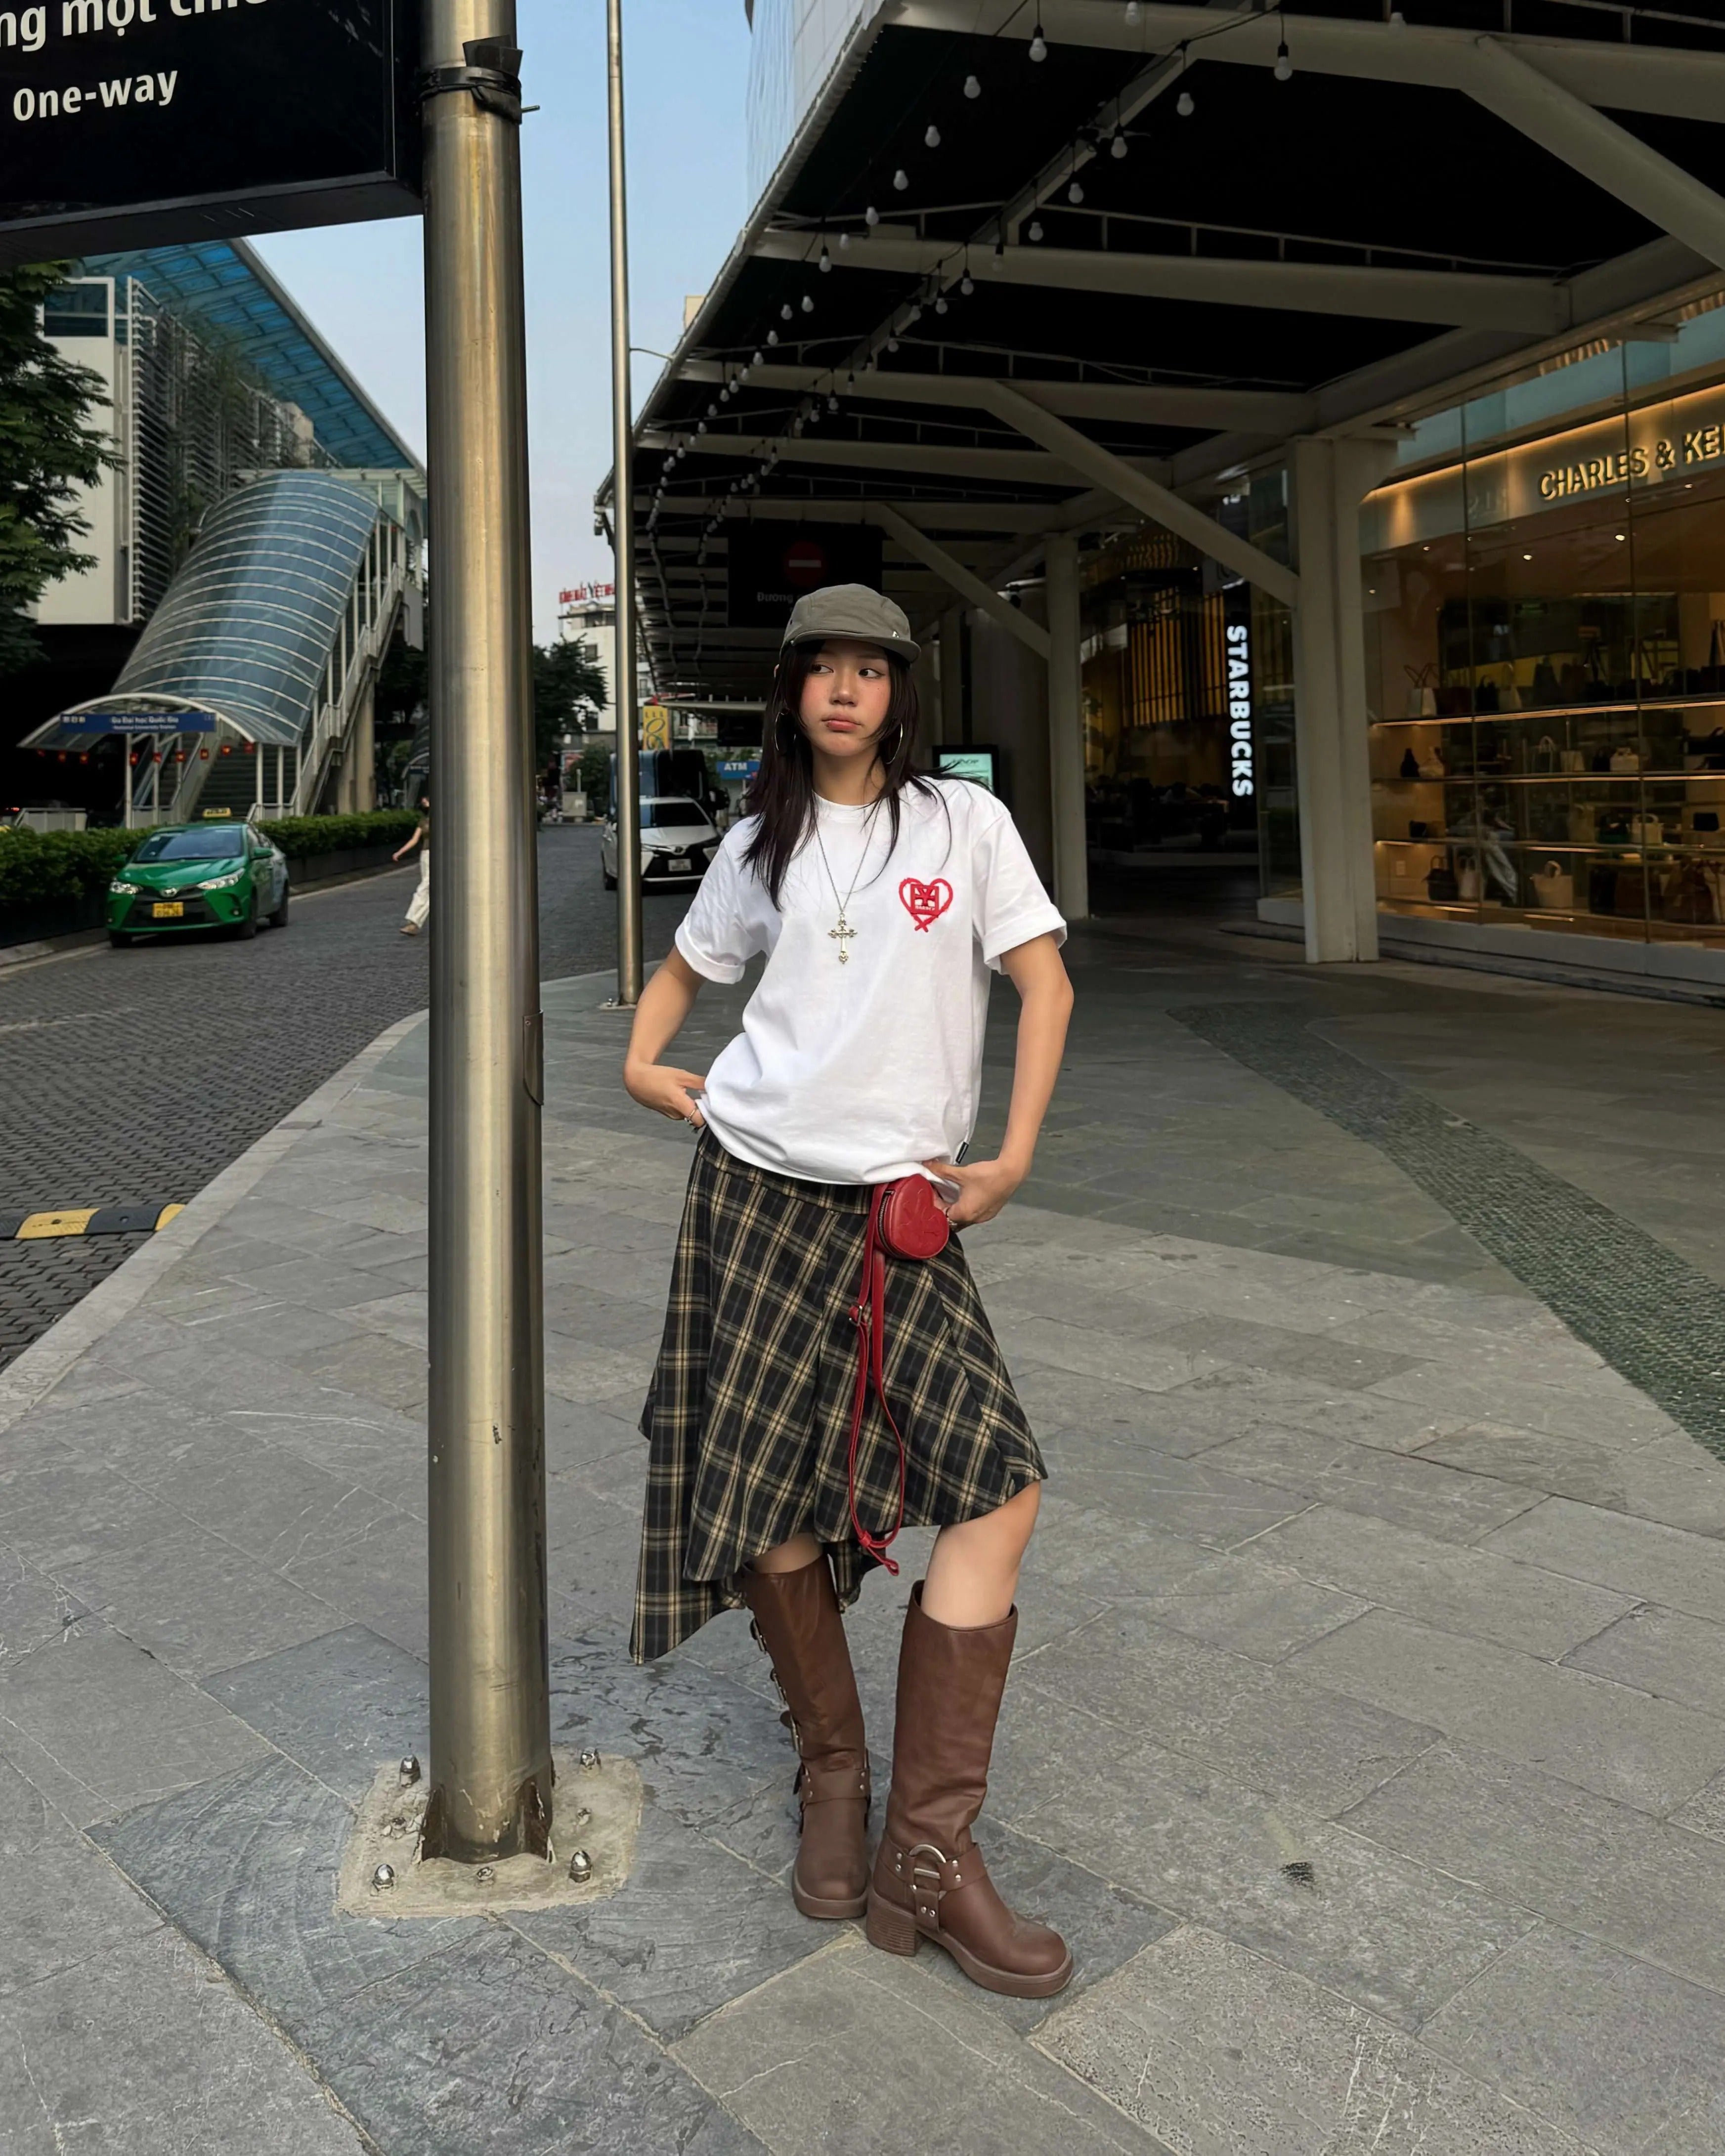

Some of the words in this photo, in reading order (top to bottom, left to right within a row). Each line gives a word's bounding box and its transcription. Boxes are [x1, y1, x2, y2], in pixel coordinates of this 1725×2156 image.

[13, 70, 178, 121] One-way
[1539, 446, 1650, 500] CHARLES
[1656, 439, 1676, 470] &
[1227, 625, 1253, 797] STARBUCKS
